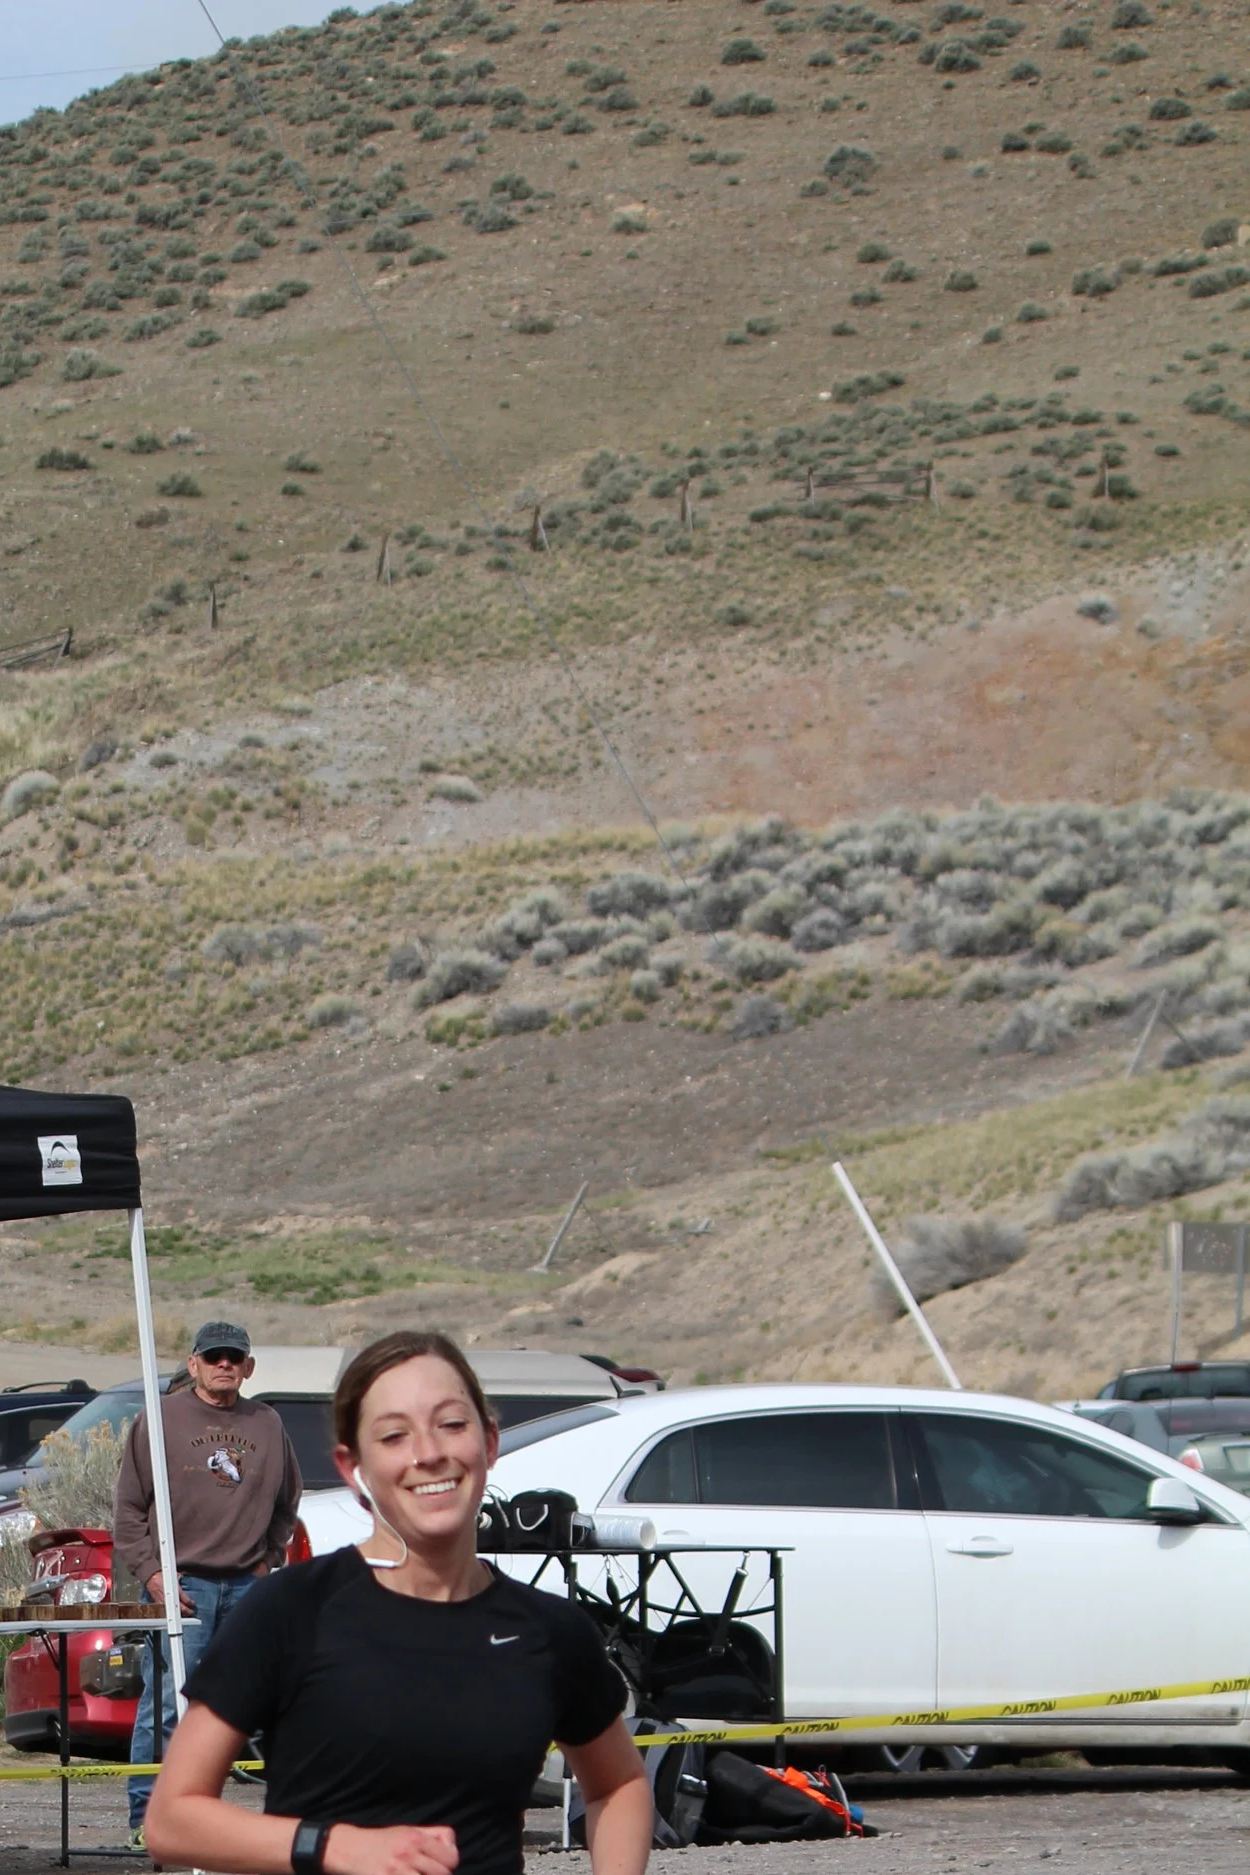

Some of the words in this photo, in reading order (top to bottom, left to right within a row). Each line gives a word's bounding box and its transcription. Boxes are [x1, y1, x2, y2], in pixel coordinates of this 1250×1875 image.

[1106, 1689, 1162, 1705] CAUTION
[1000, 1700, 1057, 1716] CAUTION
[891, 1711, 950, 1725] CAUTION
[780, 1721, 841, 1735] CAUTION
[667, 1731, 728, 1744] CAUTION
